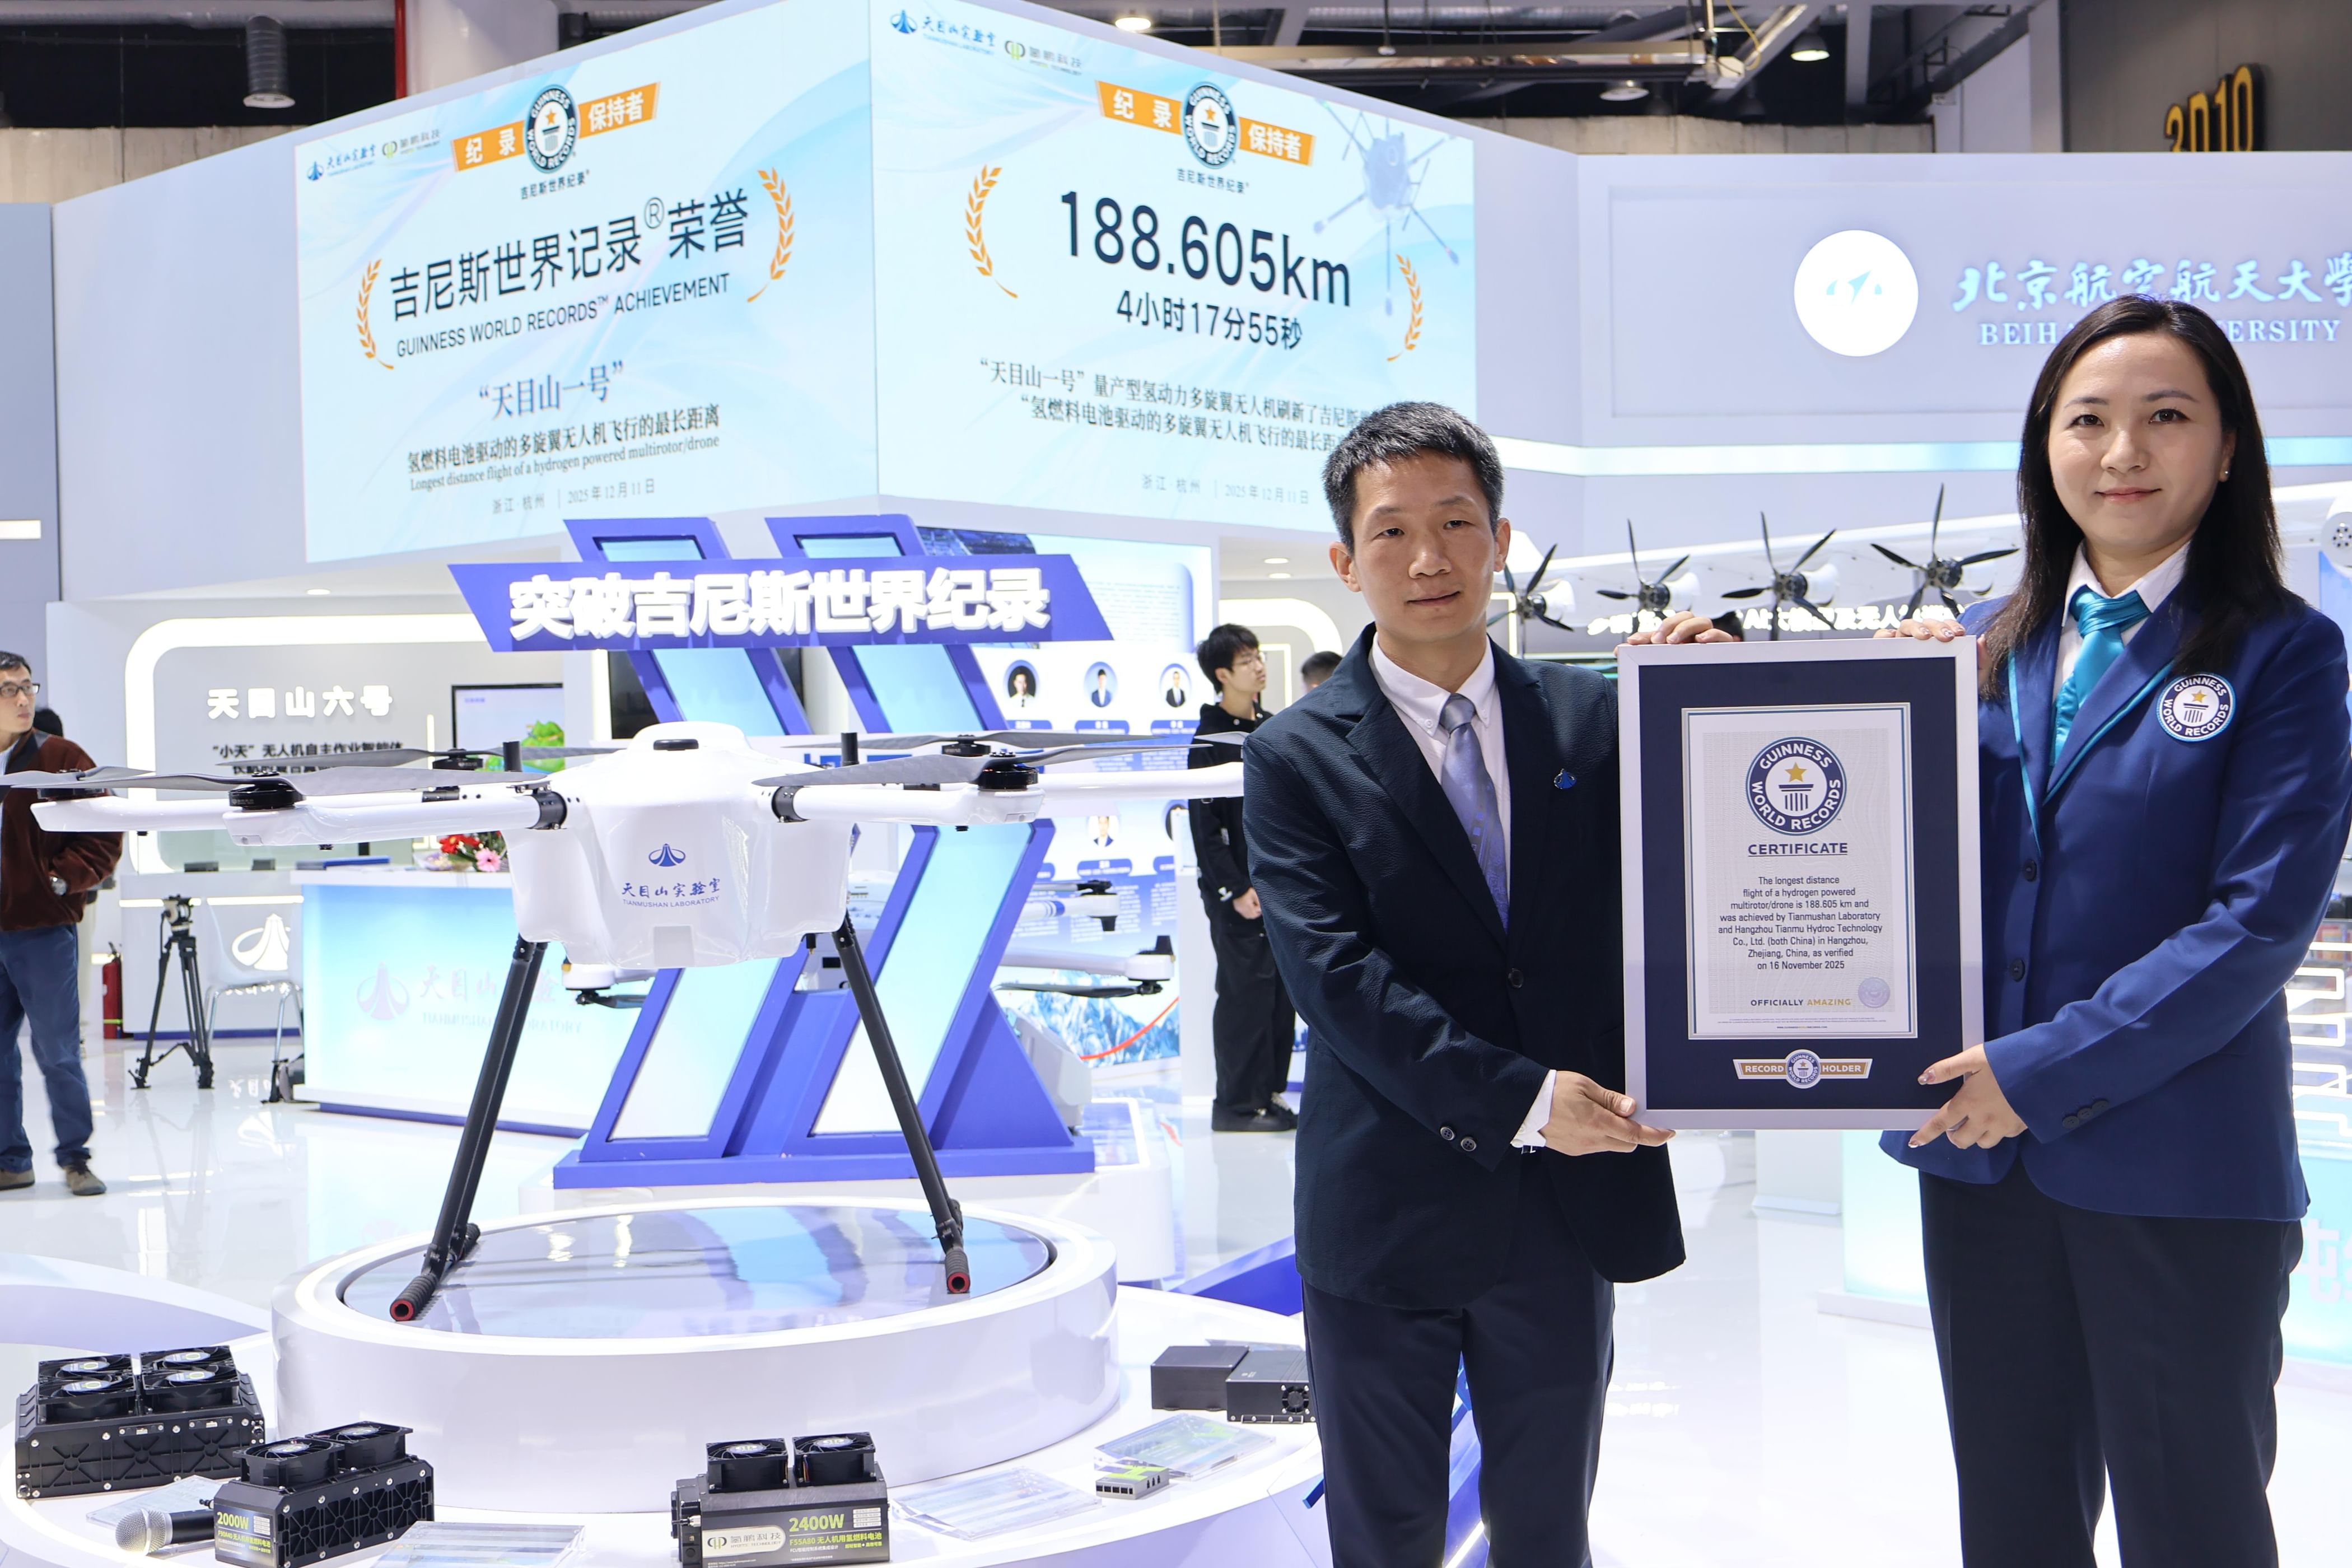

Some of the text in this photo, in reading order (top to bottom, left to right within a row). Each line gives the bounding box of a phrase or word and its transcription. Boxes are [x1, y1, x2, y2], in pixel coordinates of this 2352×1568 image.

[531, 90, 571, 118] GUINNESS
[1189, 86, 1231, 115] GUINNESS
[465, 128, 516, 165] 纪录
[587, 92, 644, 133] 保持者
[1113, 89, 1301, 161] 纪录 保持者
[528, 117, 576, 168] WORLD RECORDS
[1184, 115, 1236, 165] WORLD RECORDS
[1061, 191, 1351, 307] 188.605km
[396, 328, 465, 358] GUINNESS
[471, 316, 521, 343] WORLD
[614, 272, 730, 315] ACHIEVEMENT
[1116, 290, 1303, 350] 4小时17分55秒
[479, 360, 623, 420] “天目山一号”
[410, 435, 720, 492] Longest distance flight of a hydrogen powered multirotor/drone
[508, 567, 1051, 640] 突破吉尼斯世界纪录
[2174, 677, 2227, 696] GUINNESS
[207, 685, 393, 720] 天目山六号
[2163, 699, 2229, 736] WORLD RECORDS
[1760, 743, 1832, 770] GUINNESS
[1752, 779, 1841, 830] WORLD RECORDS
[1748, 843, 1848, 855] CERTIFICATE
[622, 878, 720, 898] 天目山实验室
[1743, 889, 1763, 898] flight
[1782, 888, 1818, 898] hydrogen
[1821, 888, 1855, 897] powered
[1775, 877, 1803, 886] longest
[623, 896, 720, 907] TIANMUSHAN LABORATORY
[1730, 901, 1793, 909] multirotor/drone
[1735, 925, 1772, 935] Hangzhou
[1807, 925, 1835, 934] Hydroc
[1837, 925, 1882, 934] Technology
[1739, 913, 1774, 921] achieved
[1776, 913, 1785, 923] by
[1788, 912, 1836, 921] Tianmushan
[1838, 912, 1880, 922] Laboratory
[1733, 937, 1748, 946] Co.,
[1768, 937, 1788, 946] (both
[1790, 937, 1816, 945] China)
[1827, 936, 1868, 945] Hangzhou,
[1748, 949, 1784, 959] Zhejiang,
[1786, 949, 1810, 958] China,
[1791, 1054, 1815, 1063] GUINNESS
[1788, 1066, 1818, 1083] WORLD RECORDS
[217, 1511, 249, 1530] 2000W
[789, 1514, 844, 1532] 2400W
